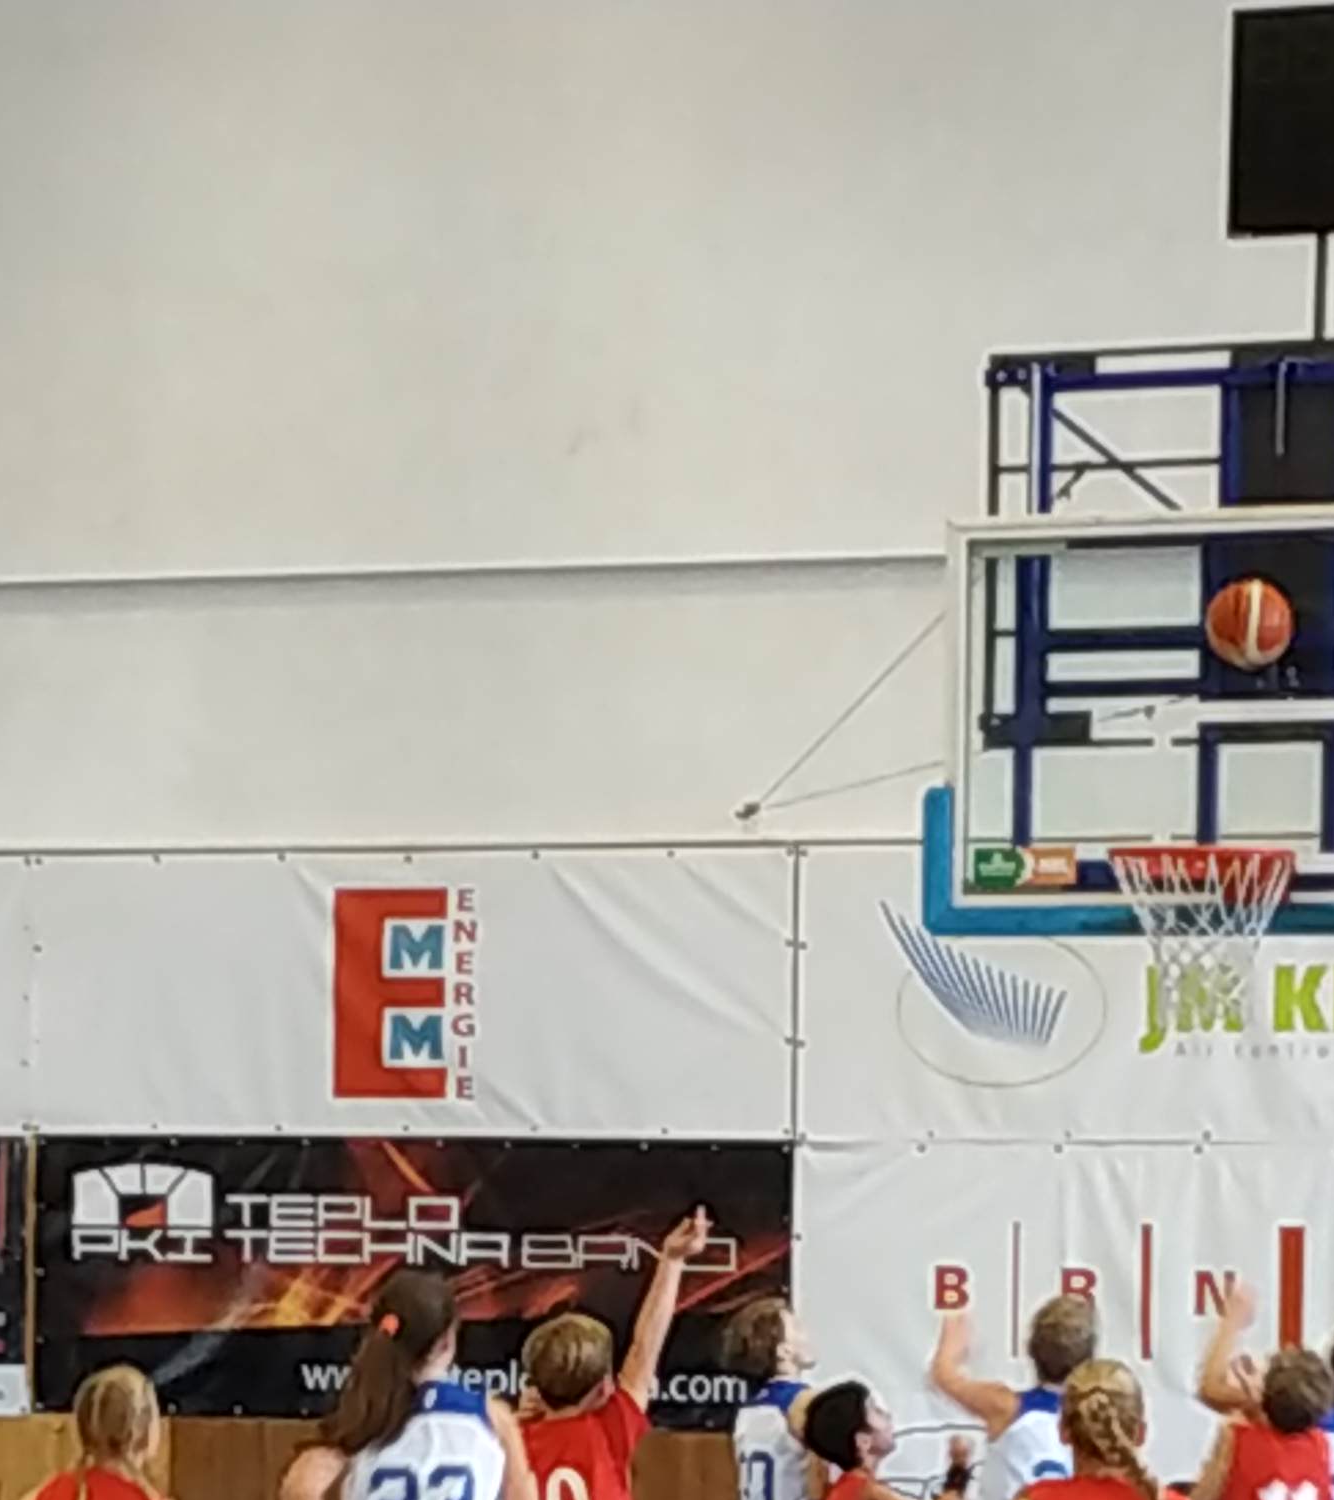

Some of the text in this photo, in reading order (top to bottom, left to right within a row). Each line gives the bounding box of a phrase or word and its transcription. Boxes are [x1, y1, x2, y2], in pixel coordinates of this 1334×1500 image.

[451, 888, 477, 1100] ENERGIE
[224, 1195, 460, 1230] TEPLO
[71, 1229, 213, 1262] PKI
[224, 1230, 510, 1268] TECHNA
